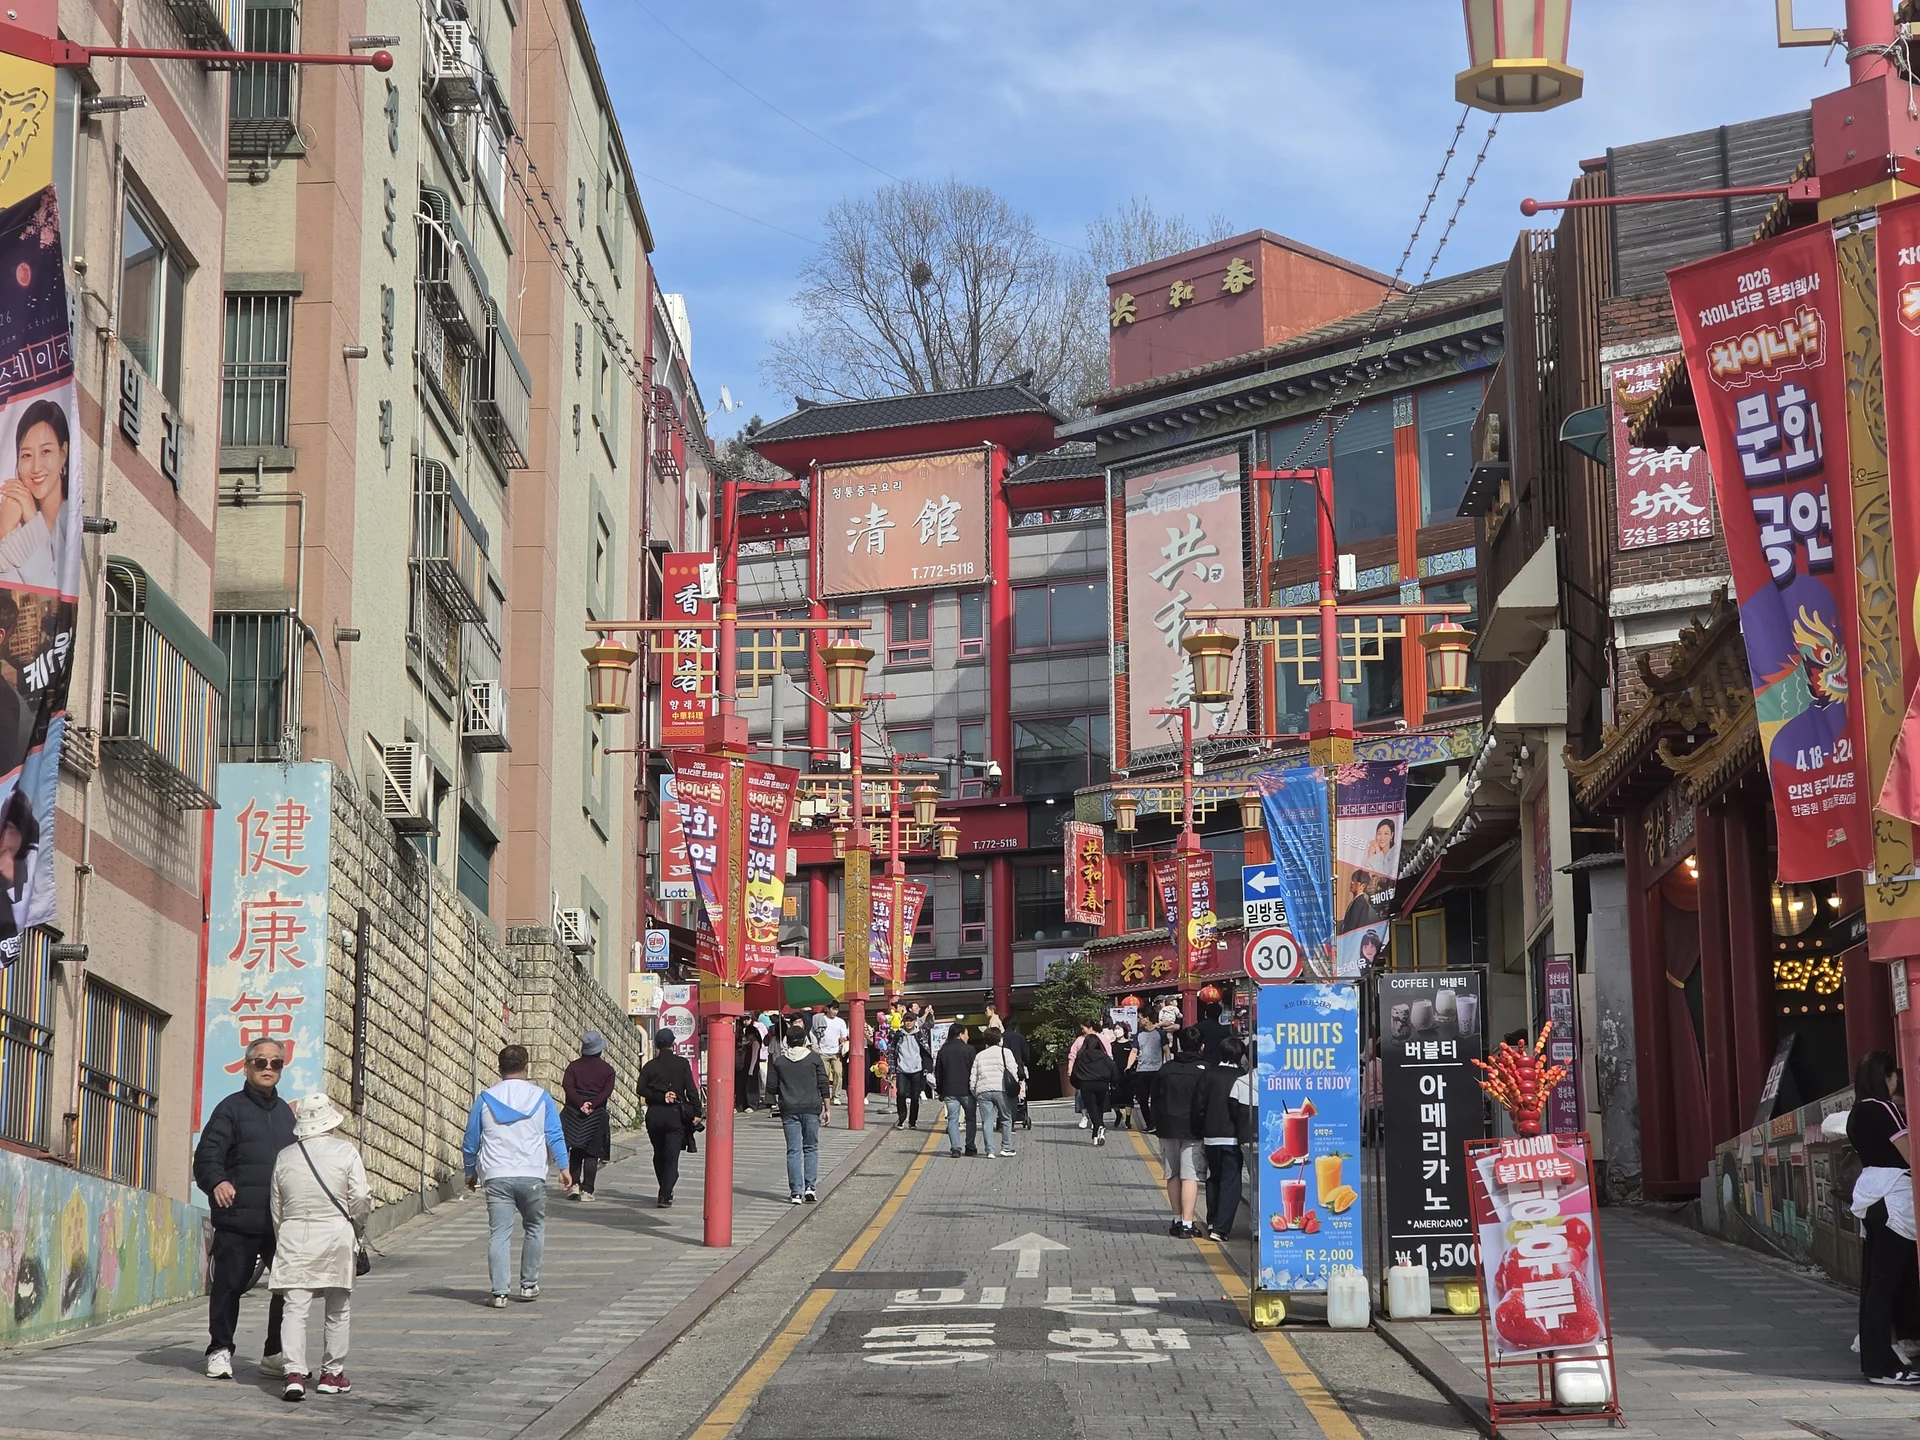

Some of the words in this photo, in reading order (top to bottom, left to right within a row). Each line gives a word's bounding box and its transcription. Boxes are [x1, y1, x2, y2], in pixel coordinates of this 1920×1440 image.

[1737, 268, 1771, 294] 2026
[1699, 293, 1764, 328] 차이나타운
[1766, 273, 1821, 307] 문화행사
[1713, 313, 1818, 373] 차이나는
[1736, 384, 1822, 477] 문화
[832, 480, 903, 499] 정통중국요리
[1150, 482, 1219, 512] 中國料理
[1623, 518, 1709, 537] 766-2916
[1623, 527, 1710, 546] 765-2916
[1753, 481, 1834, 578] 공연
[911, 562, 974, 580] T.772-5118
[672, 711, 704, 721] 中華料理
[749, 791, 784, 810] 차이나는
[1788, 782, 1815, 801] 인천
[680, 803, 718, 838] 문화
[749, 812, 777, 846] 문화
[973, 838, 1018, 850] T.772-5118
[689, 843, 717, 874] 연
[747, 848, 776, 881] 공연
[1081, 839, 1104, 911] 共和春
[1246, 900, 1288, 924] 일방통
[224, 797, 311, 1112] 健康第
[1257, 944, 1292, 971] 30
[1390, 979, 1429, 988] COFFEE
[1439, 977, 1467, 988] 버블티
[1275, 1022, 1343, 1045] FRUITS
[1284, 1048, 1336, 1071] JUICE
[1405, 1040, 1457, 1060] 버블티
[1267, 1077, 1302, 1091] DRINK
[1305, 1077, 1314, 1090] &
[1316, 1076, 1352, 1090] ENJOY
[1419, 1074, 1451, 1211] 아메리카노
[1502, 1135, 1555, 1159] 치아에
[1499, 1161, 1534, 1183] 붙지
[1536, 1158, 1571, 1178] 않는
[1412, 1219, 1464, 1229] AMERICANO
[1306, 1249, 1316, 1261] R
[1319, 1249, 1354, 1263] 2,000
[1306, 1264, 1315, 1276] L
[861, 1322, 1195, 1365] 통행
